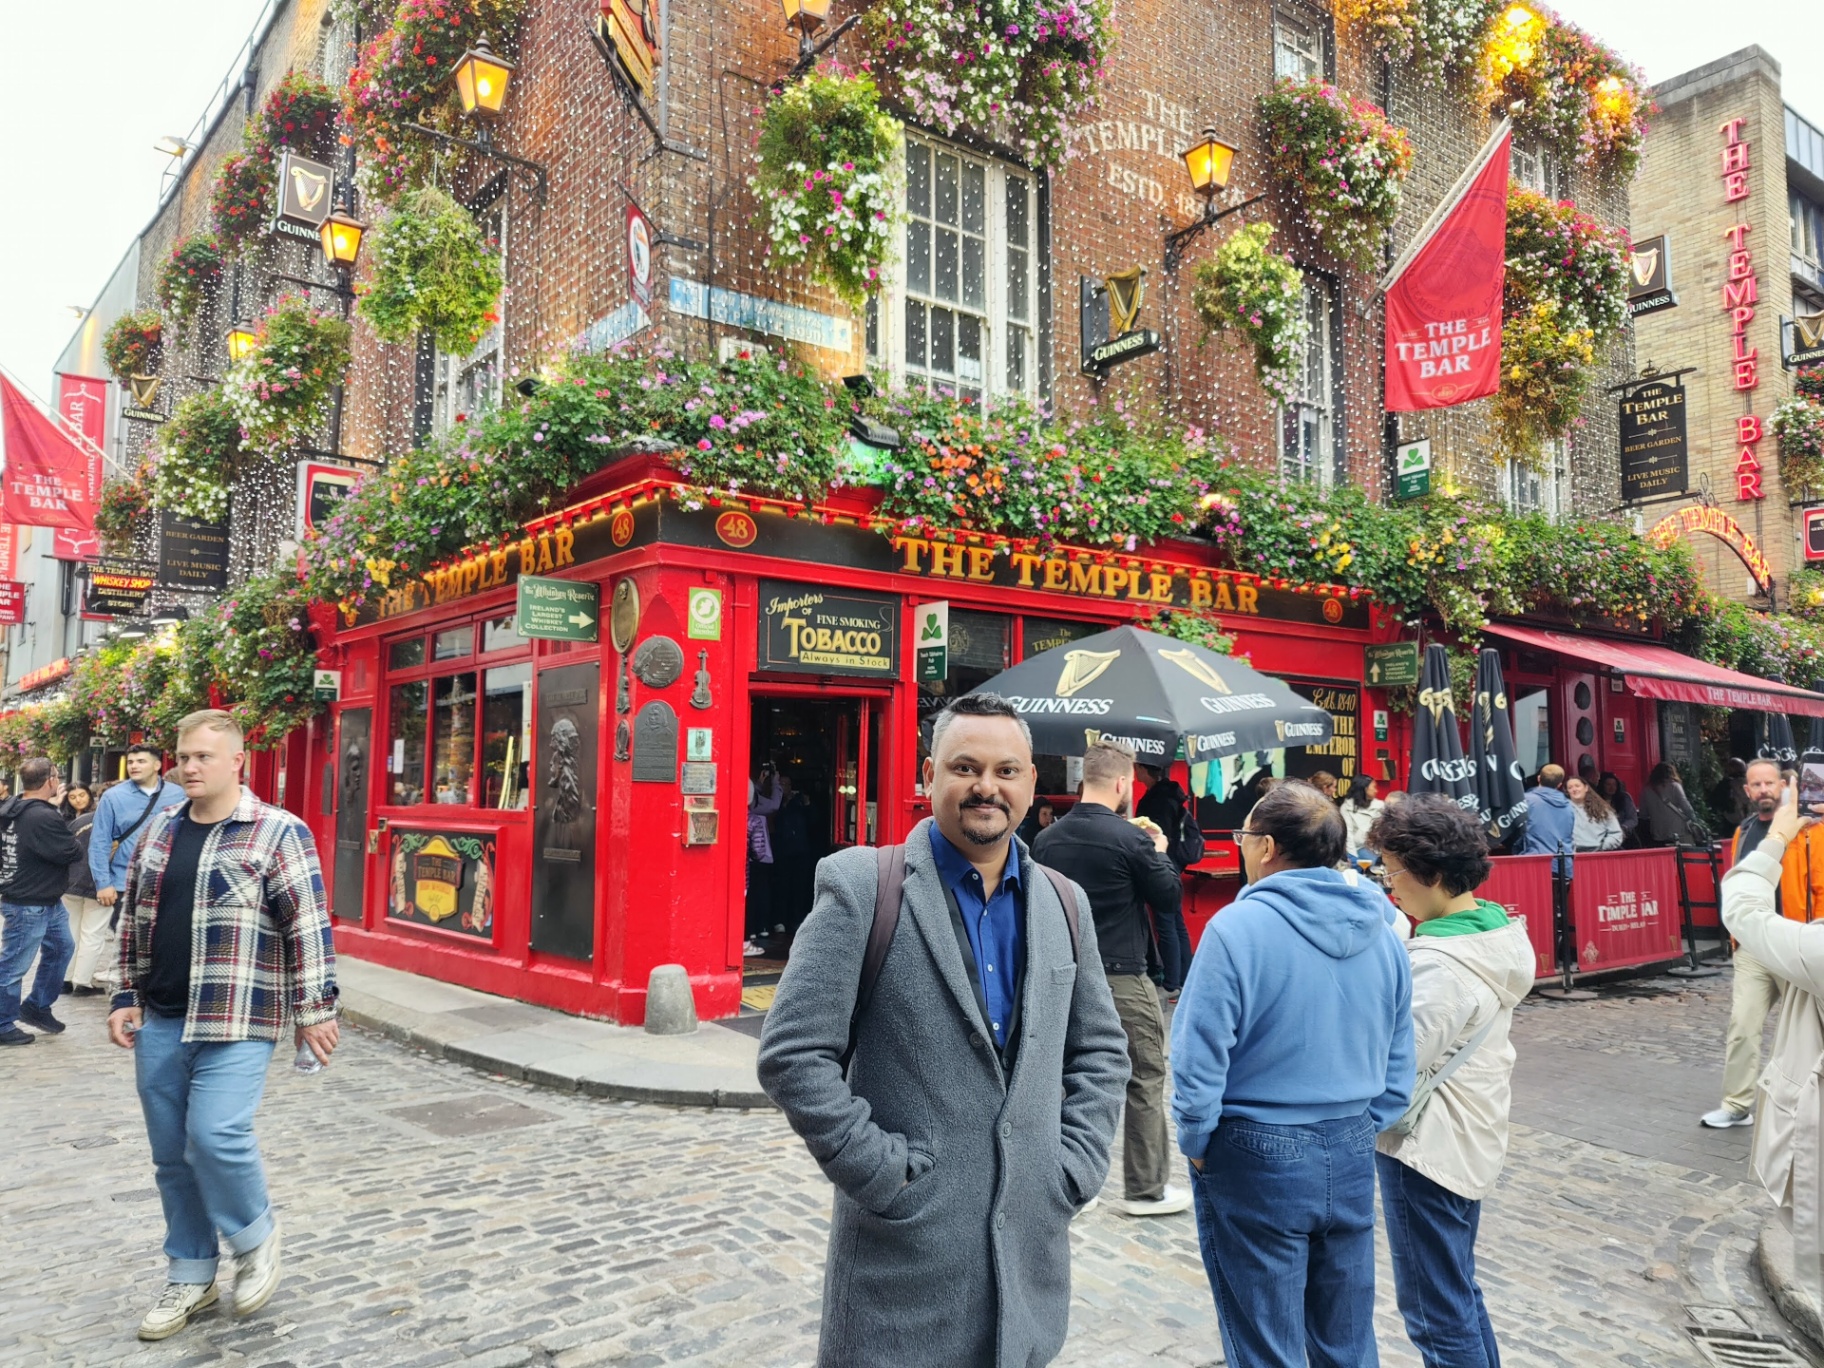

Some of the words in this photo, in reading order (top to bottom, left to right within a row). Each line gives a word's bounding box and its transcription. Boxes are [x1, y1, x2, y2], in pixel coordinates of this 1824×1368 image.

[1142, 89, 1193, 137] THE
[1718, 117, 1750, 203] THE
[277, 220, 322, 242] GUINNE
[1722, 223, 1758, 393] TEMPLE
[1424, 319, 1468, 338] THE
[1094, 332, 1145, 361] GUINNESS
[1395, 327, 1492, 362] TEMPLE
[1789, 349, 1824, 363] GUINNE
[1420, 355, 1472, 379] BAR
[1641, 388, 1662, 398] THE
[1622, 394, 1683, 415] TEMPLE
[123, 408, 164, 422] GUINNESS
[1636, 411, 1669, 426] BAR
[1624, 442, 1646, 453] BEER
[1647, 436, 1682, 449] GARDEN
[1736, 415, 1767, 501] BAR
[32, 473, 63, 486] THE
[1627, 472, 1648, 482] LIVE
[1650, 466, 1680, 478] MUSIC
[10, 481, 84, 502] TEMPLE
[1640, 478, 1668, 489] DAILY
[30, 496, 68, 511] BAR
[614, 518, 630, 540] 48
[722, 517, 748, 539] 48
[189, 533, 225, 543] GARDEN
[519, 530, 575, 576] BAR
[1680, 505, 1740, 543] TEMPLE
[1741, 533, 1772, 590] BAR
[87, 565, 104, 573] THE
[106, 567, 138, 577] TEMPLE
[166, 559, 189, 568] LIVE
[190, 562, 222, 571] MUSIC
[93, 574, 130, 588] WHISKEY
[130, 577, 152, 589] SHOP
[179, 569, 209, 579] DAILY
[893, 536, 995, 584] THE
[1012, 552, 1175, 604] TEMPLE
[1189, 578, 1259, 614] BAR
[97, 587, 146, 598] DISTILLERY
[529, 604, 566, 614] IRELAND'S
[765, 593, 824, 617] Importers
[801, 606, 813, 616] OF
[530, 617, 563, 626] WHISKEY
[531, 611, 563, 619] LARGEST
[817, 614, 839, 626] FINE
[839, 615, 881, 630] SMOKING
[524, 623, 569, 633] COLLECTION
[780, 616, 882, 658] TOBACCO
[1031, 638, 1069, 652] TEMPL
[802, 651, 841, 665] Always
[845, 655, 855, 664] in
[858, 656, 888, 668] Stock
[1201, 692, 1277, 715] GUINNESS
[1707, 686, 1724, 701] THE
[1726, 689, 1757, 705] TEMPLE
[1757, 694, 1772, 707] BAR
[1008, 695, 1114, 716] GUINNESS
[1285, 721, 1323, 737] GUINNESS
[1332, 715, 1355, 735] THE
[1197, 731, 1237, 751] GUINNESS
[1341, 758, 1356, 777] OF
[417, 866, 442, 879] TEMPLE
[442, 869, 456, 881] BAR
[1620, 891, 1637, 904] THE
